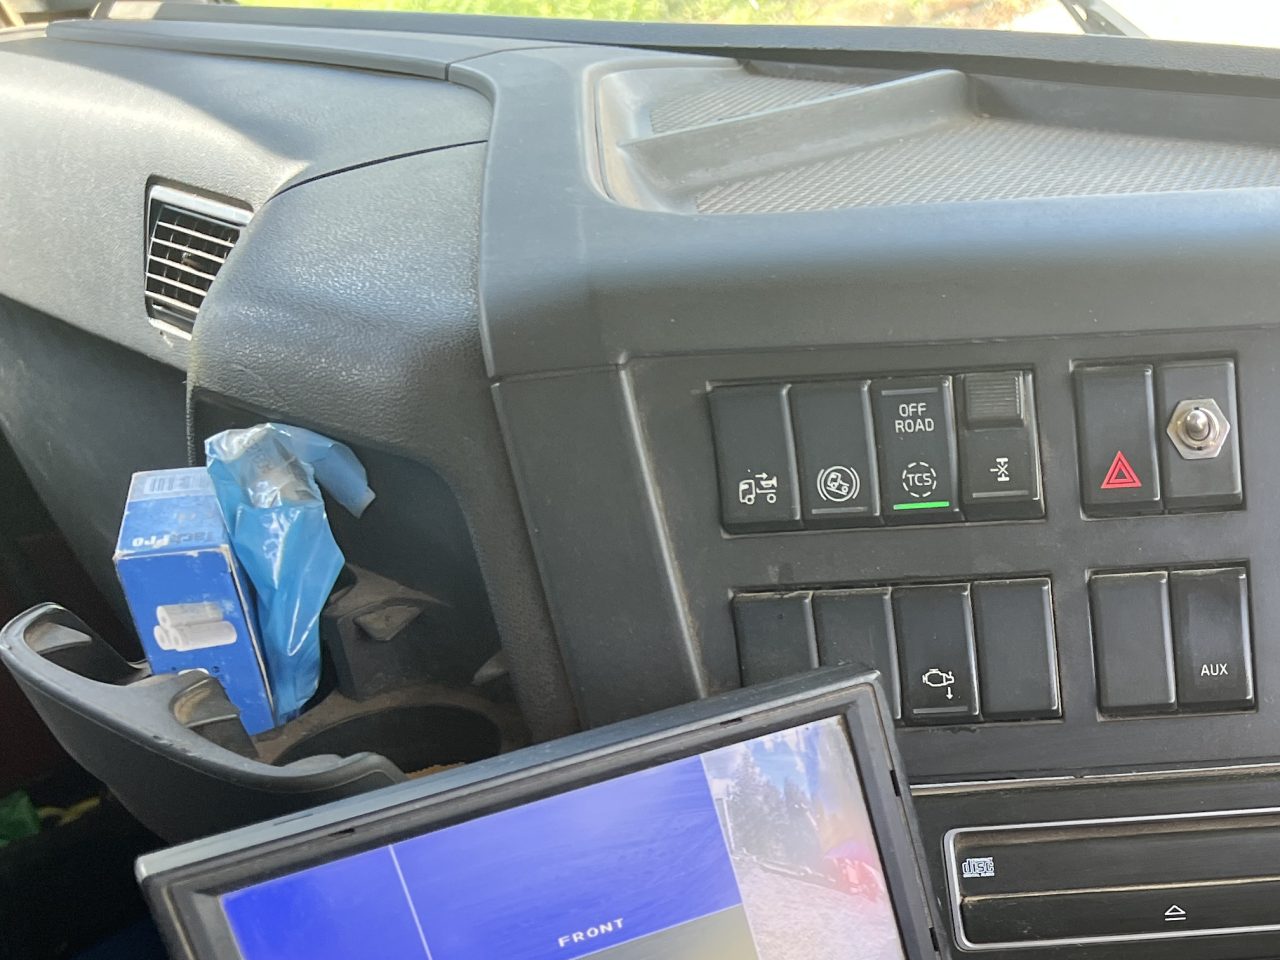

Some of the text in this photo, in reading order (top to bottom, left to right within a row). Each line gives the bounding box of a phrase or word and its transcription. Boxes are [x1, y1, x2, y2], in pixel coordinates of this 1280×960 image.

[899, 403, 926, 417] OFF
[895, 418, 934, 433] ROAD
[907, 473, 932, 486] TCS
[1201, 664, 1228, 676] AUX
[558, 918, 623, 947] FRONT
